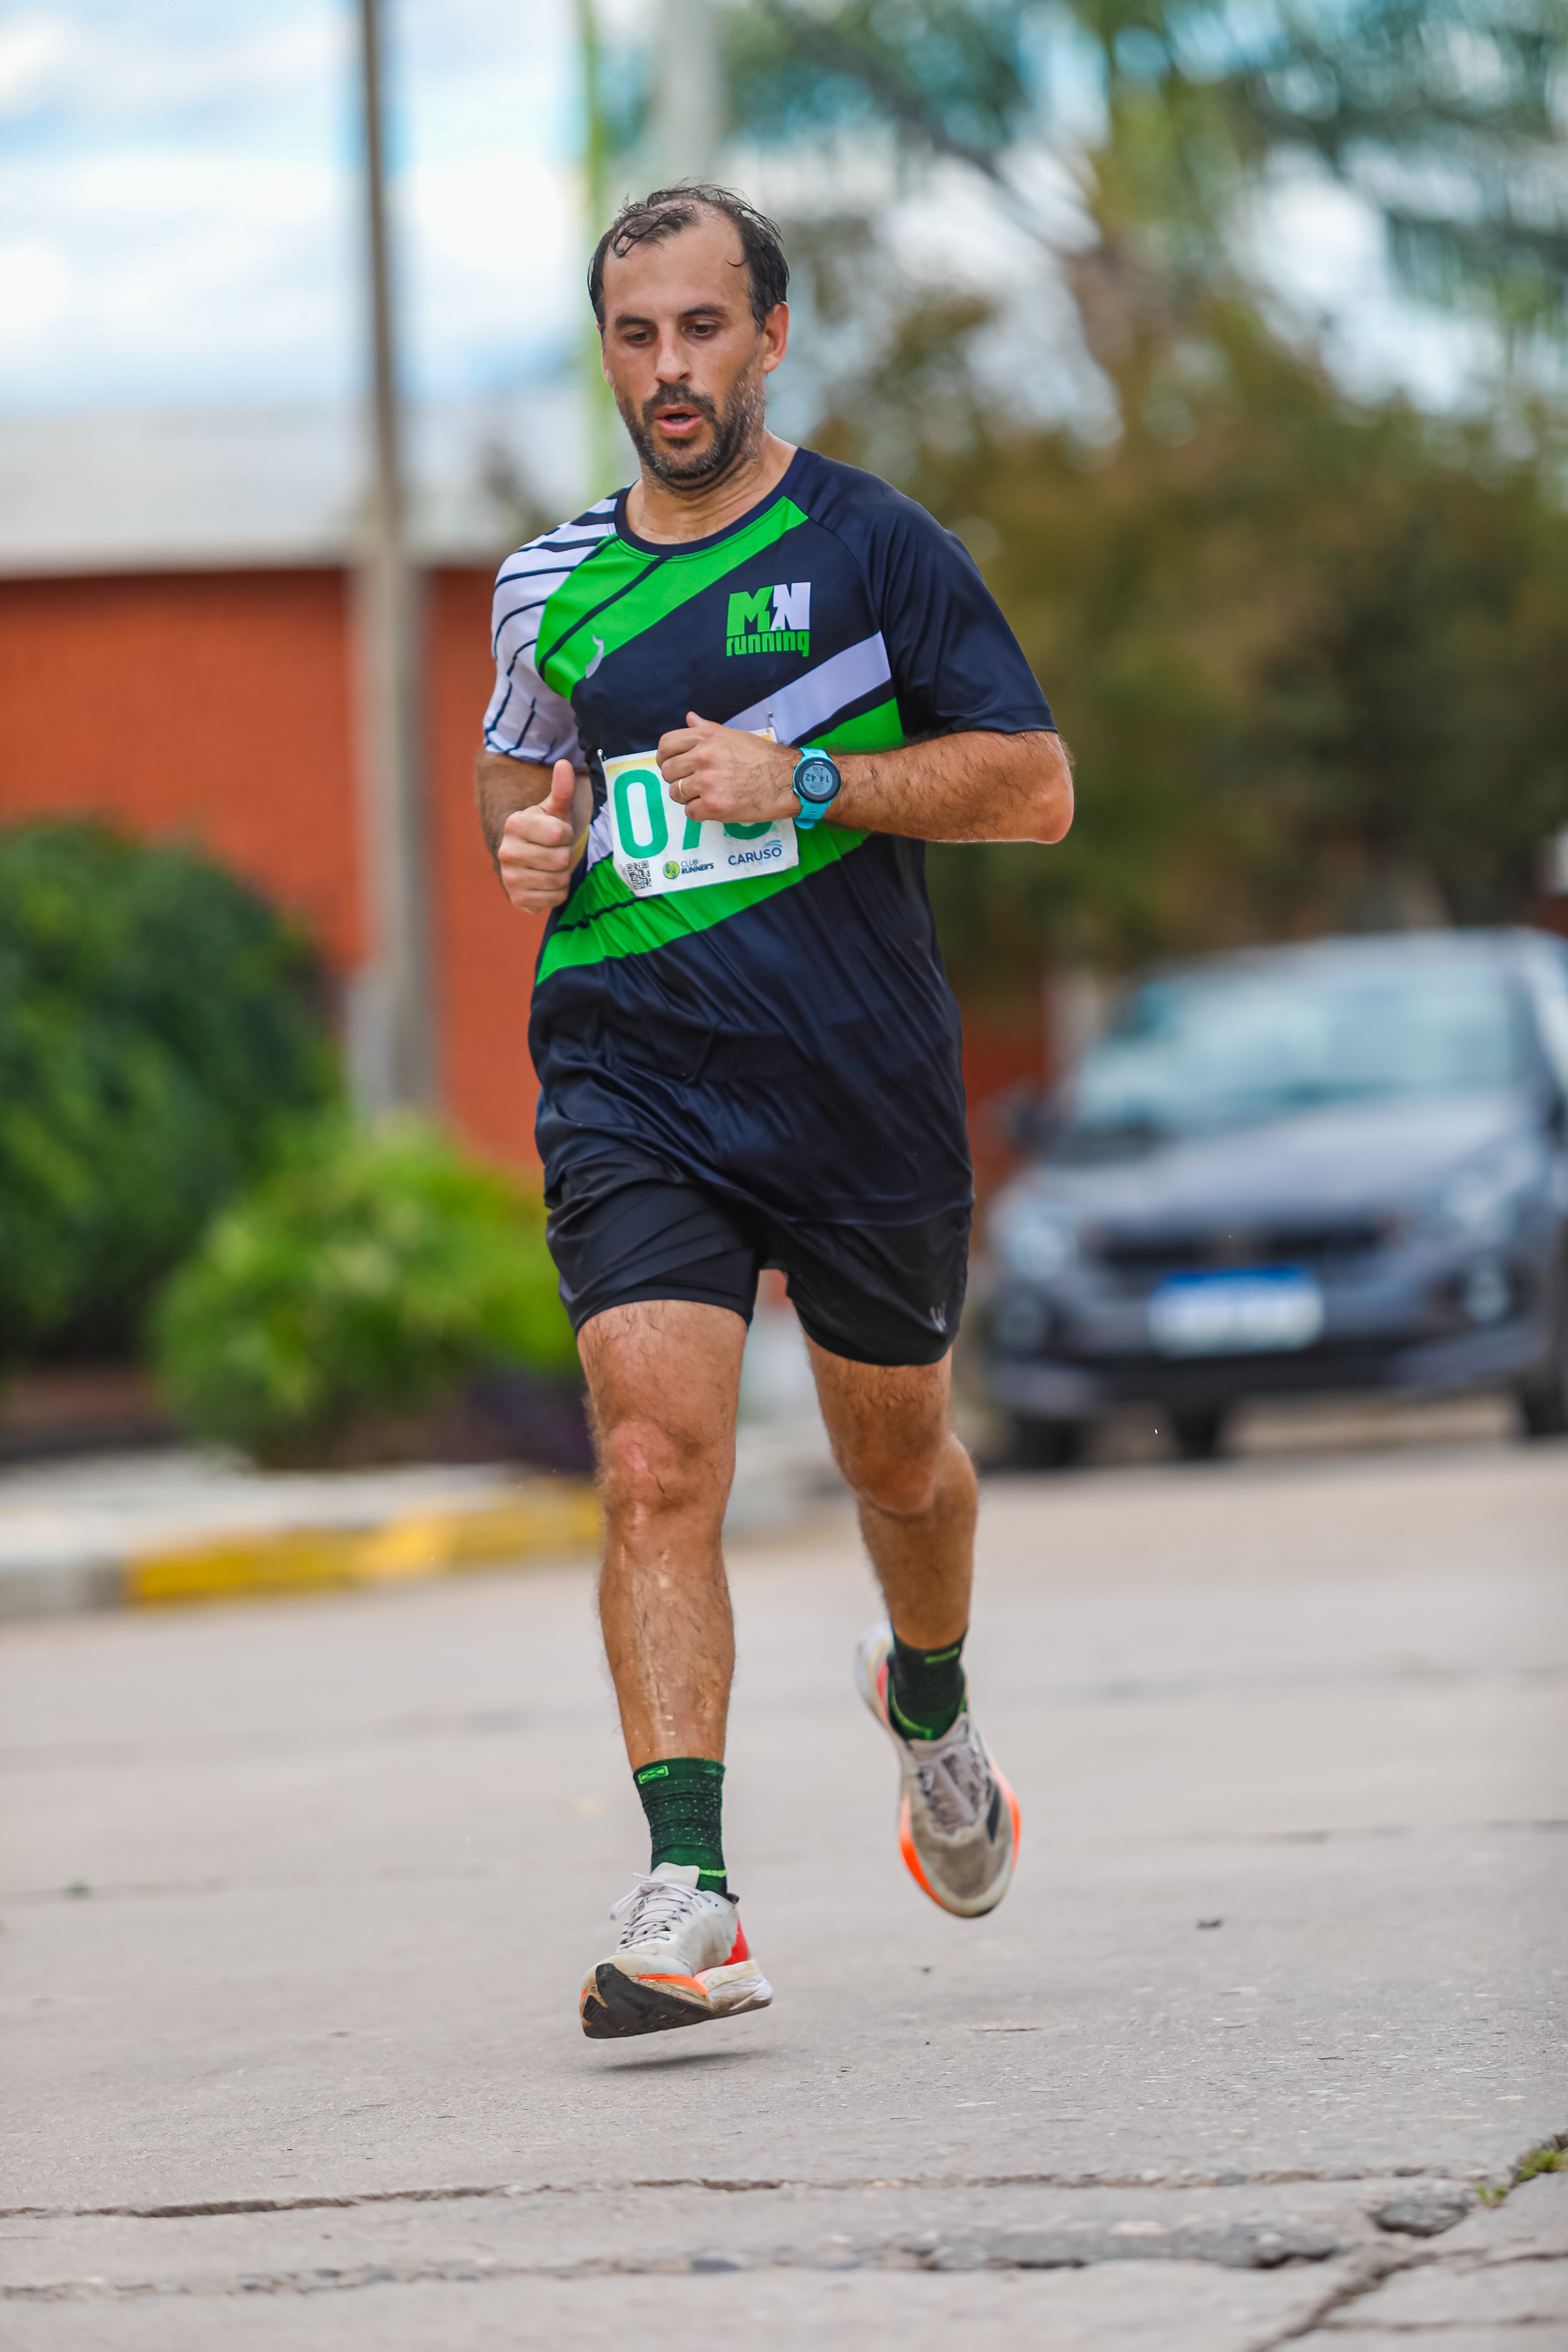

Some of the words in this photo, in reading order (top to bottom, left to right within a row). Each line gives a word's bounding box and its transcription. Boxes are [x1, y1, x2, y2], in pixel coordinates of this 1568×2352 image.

[727, 582, 811, 636] MN
[727, 626, 810, 657] running
[805, 773, 829, 782] 14.42
[681, 858, 698, 867] CLUB
[728, 847, 781, 865] CARUSO
